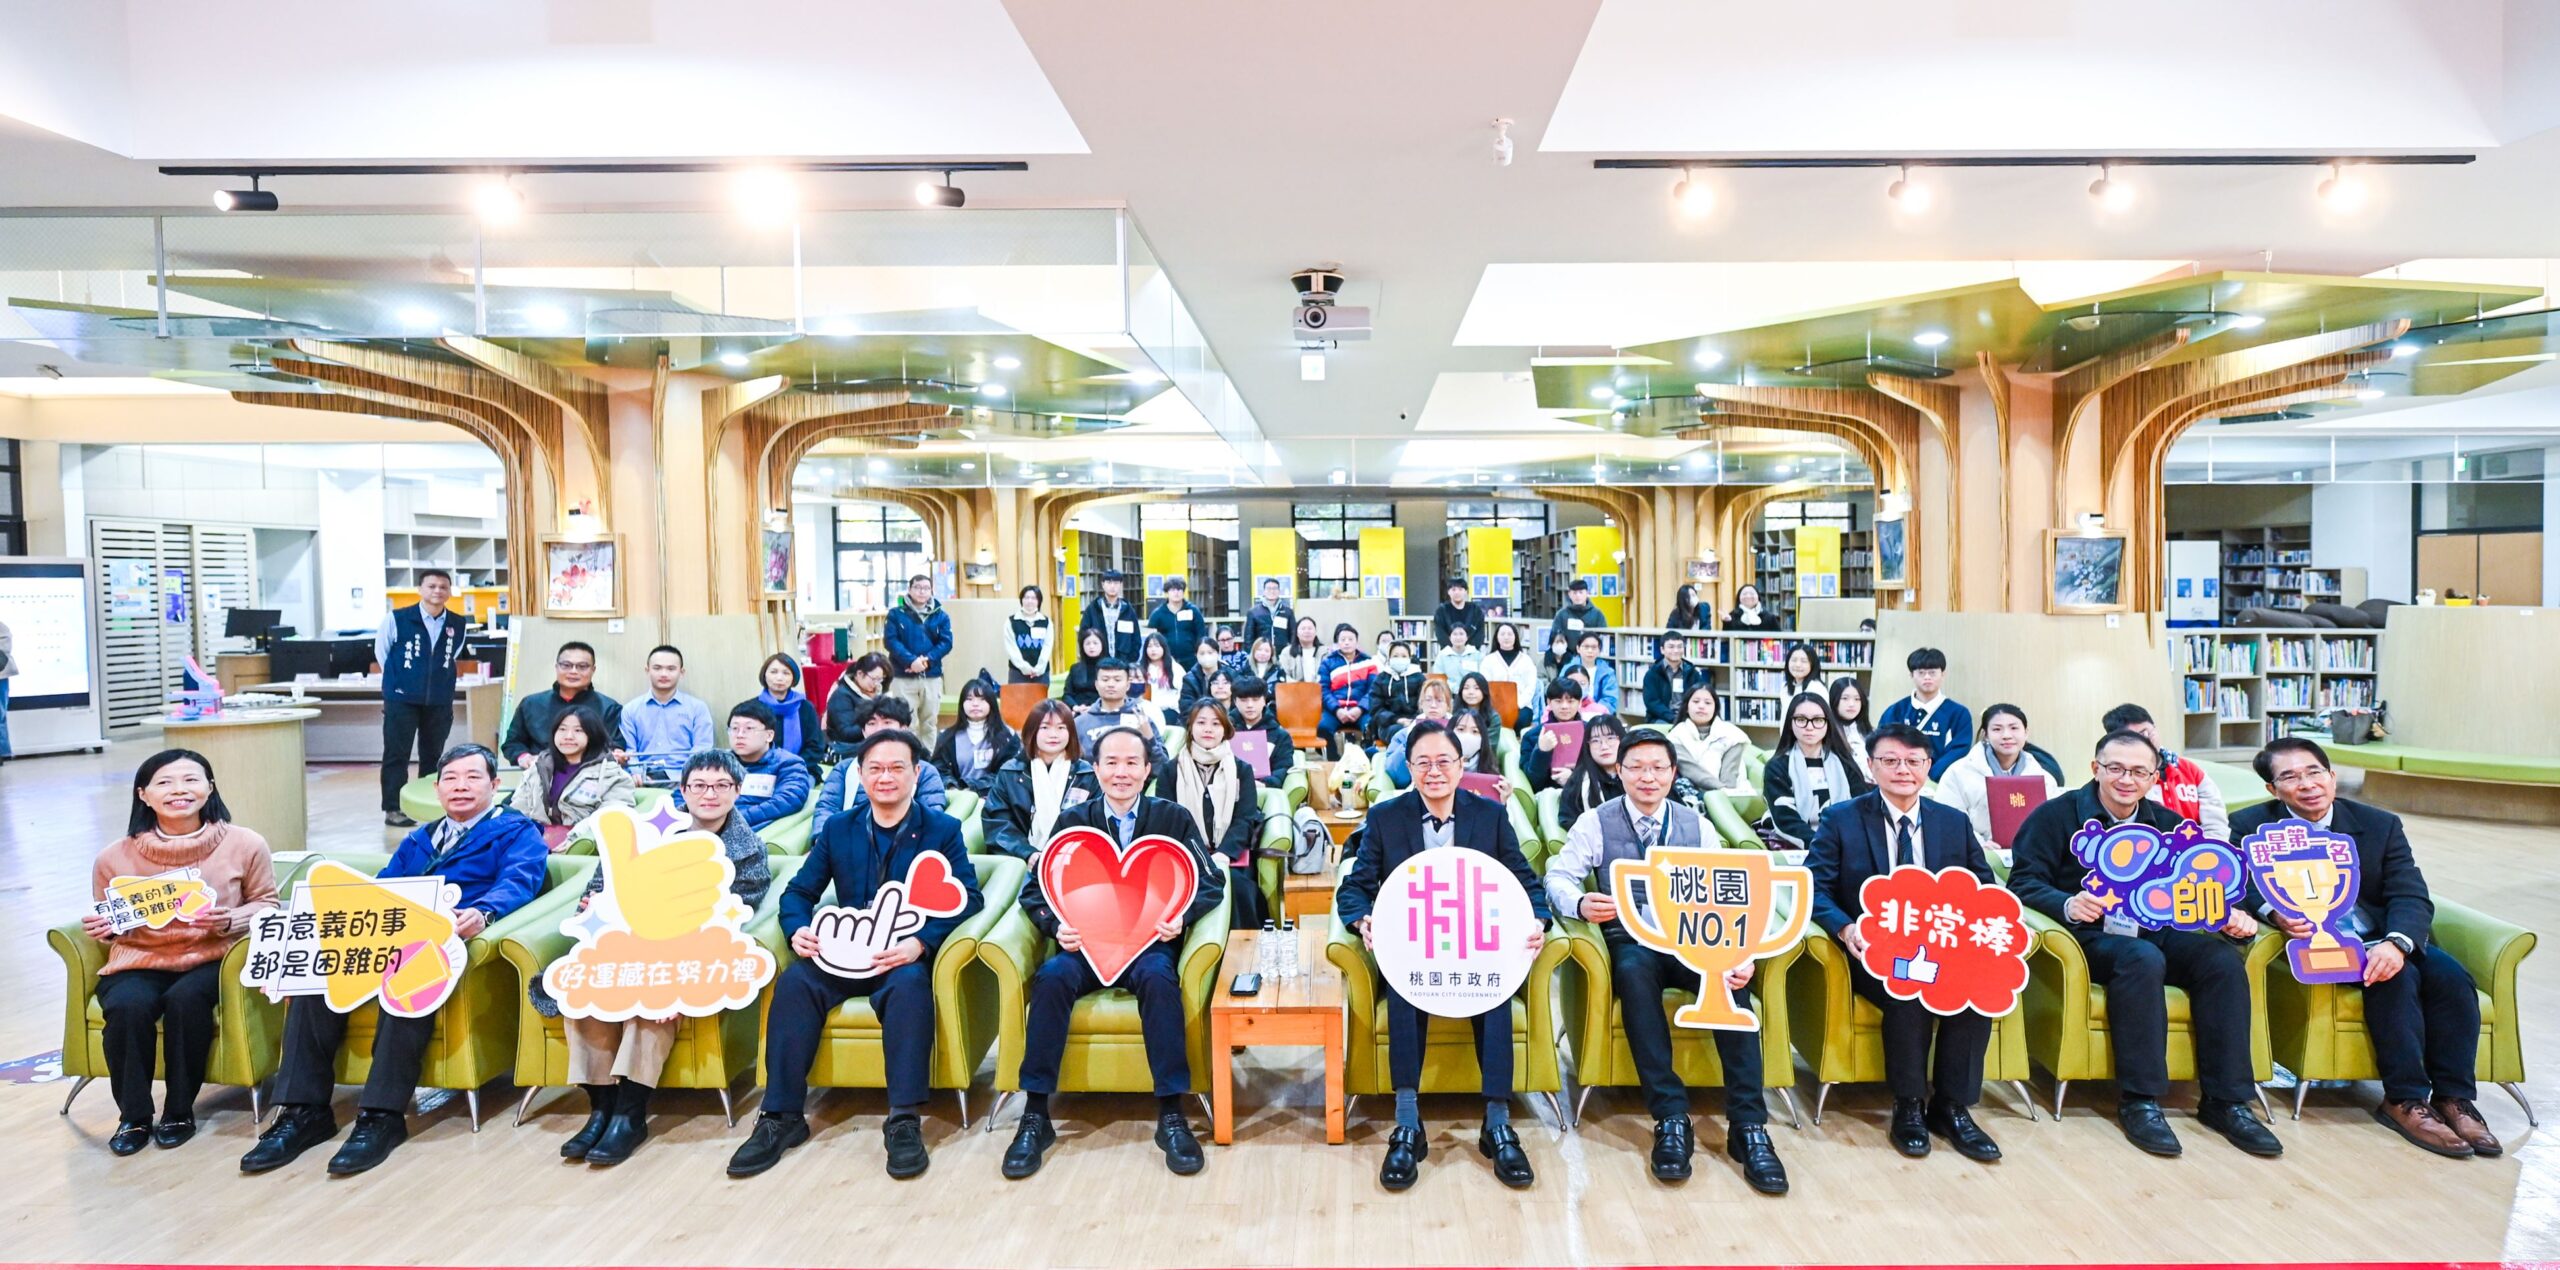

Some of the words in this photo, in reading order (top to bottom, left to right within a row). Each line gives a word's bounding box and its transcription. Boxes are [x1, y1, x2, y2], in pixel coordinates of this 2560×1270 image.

[2178, 783, 2199, 803] 09
[2252, 828, 2351, 864] 我是第一名
[93, 882, 177, 915] 有意義的事
[1670, 865, 1749, 906] 桃園
[2172, 876, 2225, 926] 帥
[258, 907, 408, 942] 有意義的事
[1678, 912, 1747, 947] NO.1
[1878, 898, 2015, 955] 非常棒
[249, 945, 403, 981] 都是困難的
[558, 957, 758, 989] 好運藏在努力裡
[1409, 971, 1501, 987] 桃園市政府
[1458, 991, 1502, 999] GOVERNMENT
